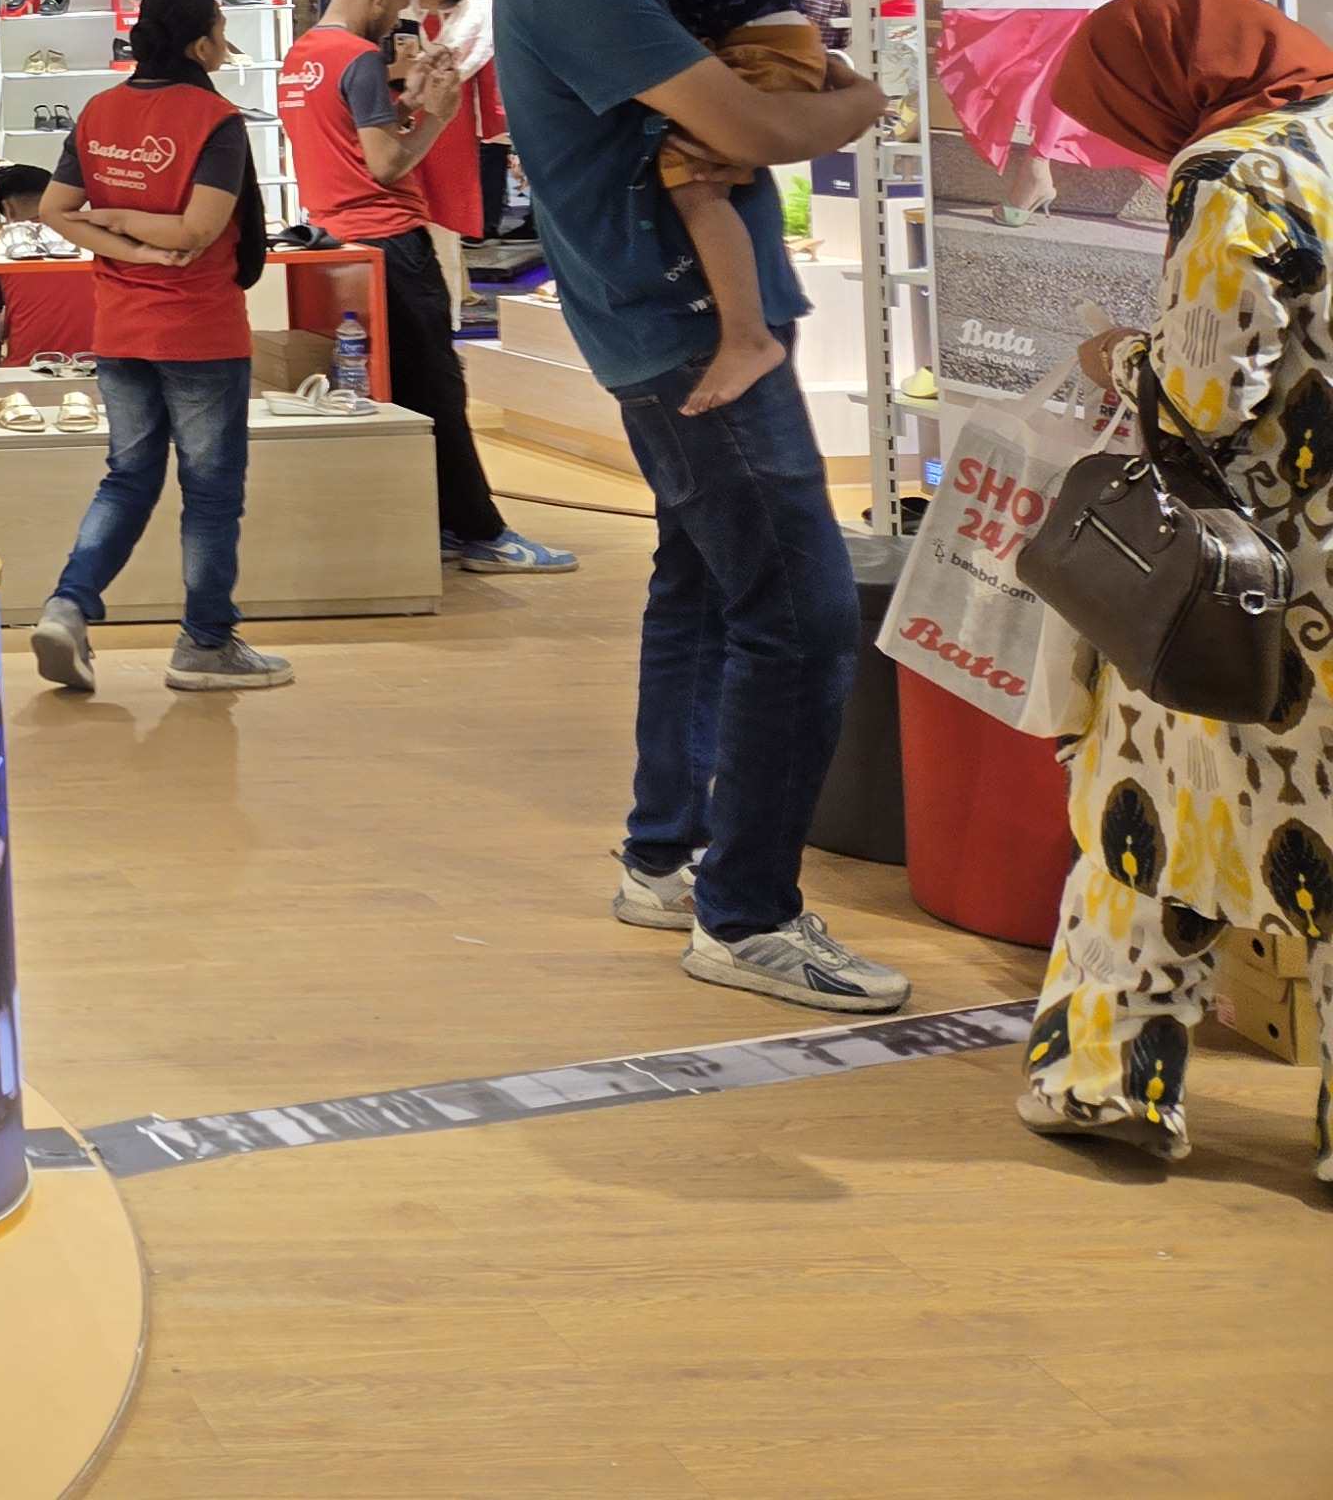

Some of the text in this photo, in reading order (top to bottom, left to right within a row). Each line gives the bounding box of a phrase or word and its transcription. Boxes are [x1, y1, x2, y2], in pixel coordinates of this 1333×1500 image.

[87, 140, 130, 159] Bata
[958, 319, 1035, 356] Bata
[959, 347, 1037, 370] MAKE YOUR WAY
[954, 457, 1056, 526] SHO
[957, 508, 1033, 561] 24/
[950, 552, 1036, 604] batabd.com
[899, 617, 1026, 696] Bata
